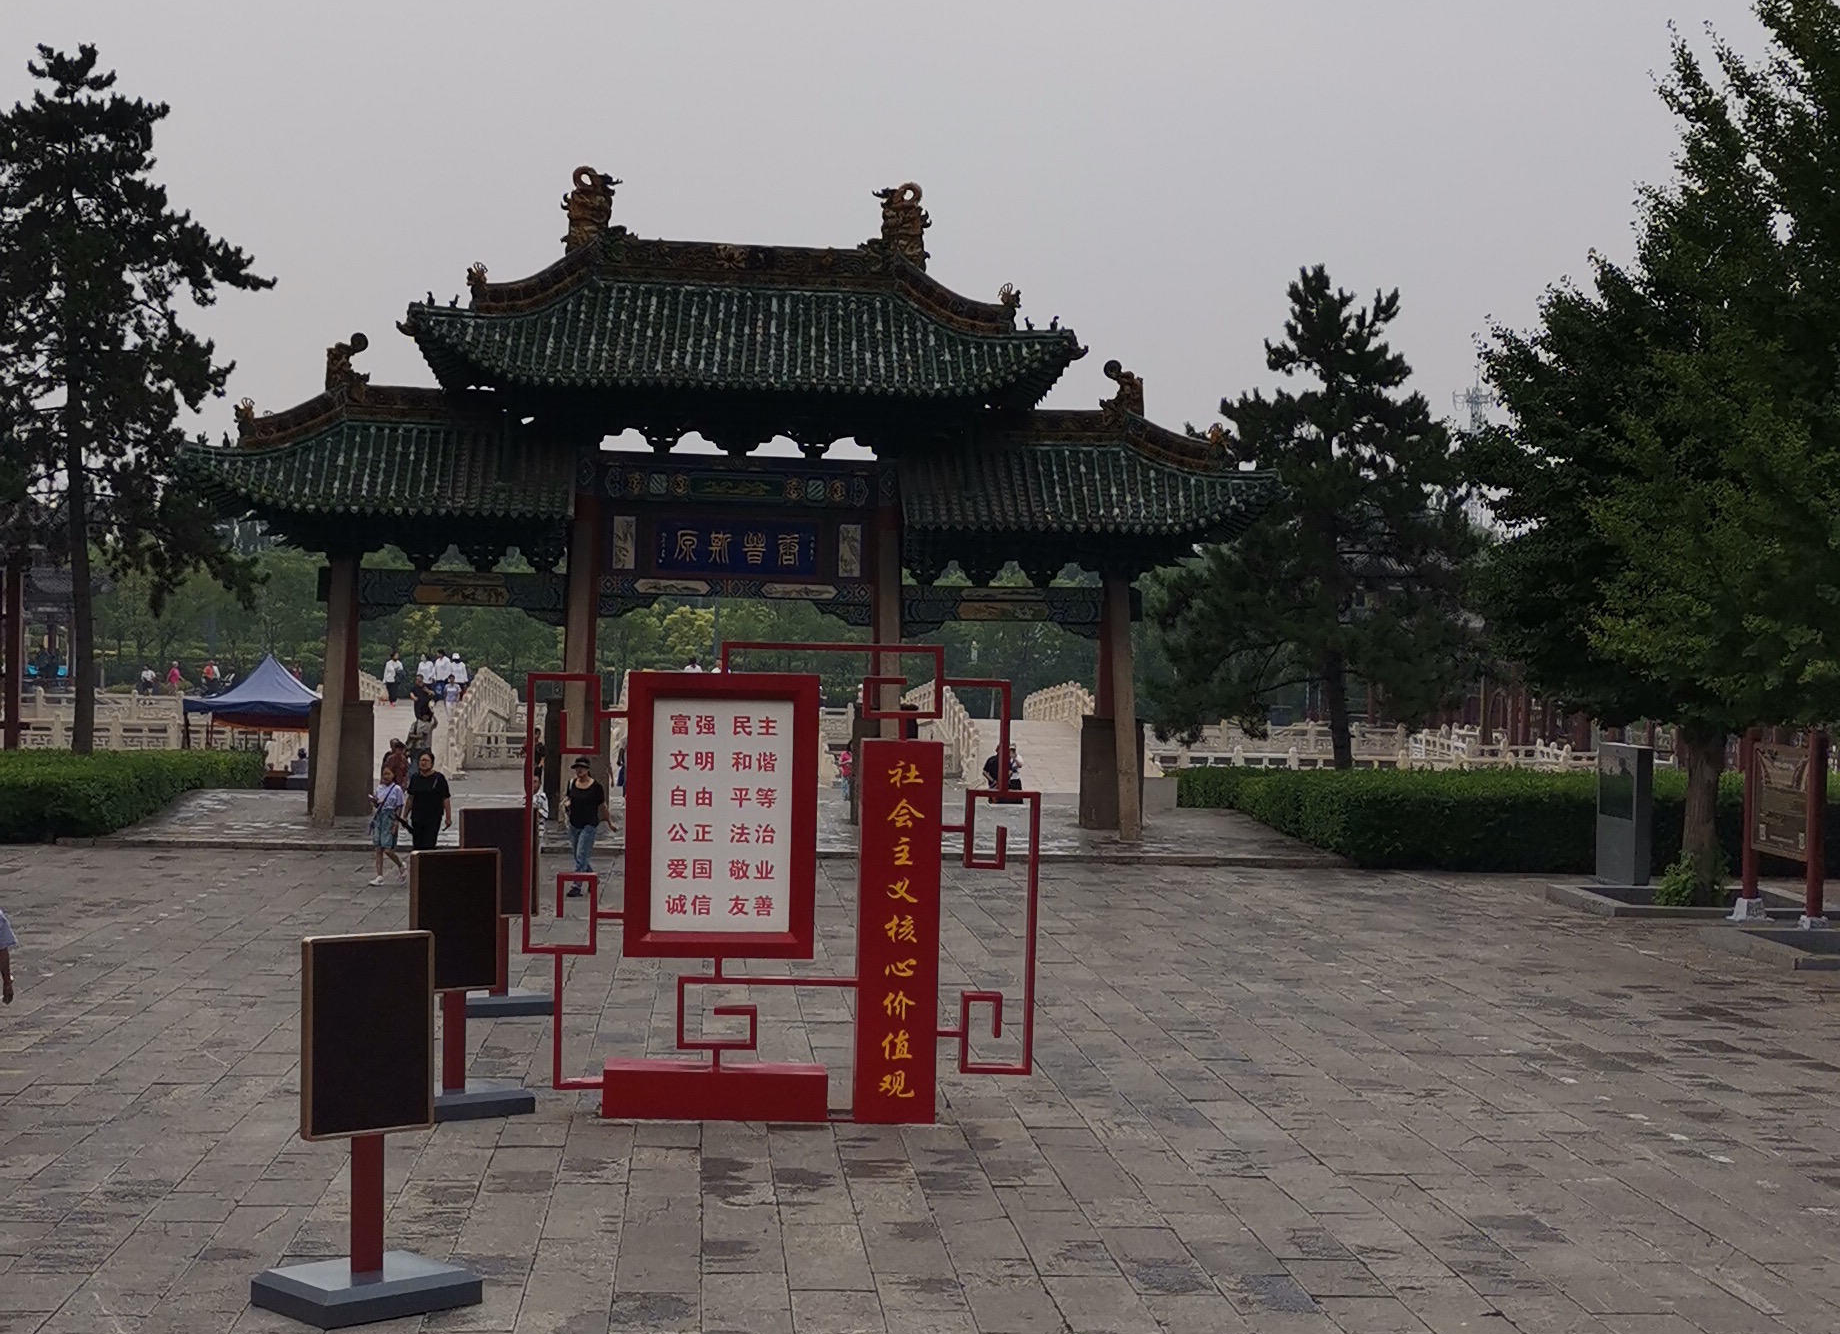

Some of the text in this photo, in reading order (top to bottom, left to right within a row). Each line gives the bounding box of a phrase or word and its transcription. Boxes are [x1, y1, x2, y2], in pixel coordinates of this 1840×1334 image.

[670, 714, 776, 738] 富强 民主
[671, 750, 777, 775] 文明 和谐
[669, 785, 777, 808] 自由 平等
[667, 822, 775, 846] 公正 法治
[667, 858, 774, 883] 爱国 敬业
[665, 894, 775, 917] 诚信 友善
[879, 761, 924, 1097] 社会主义核心价值观
